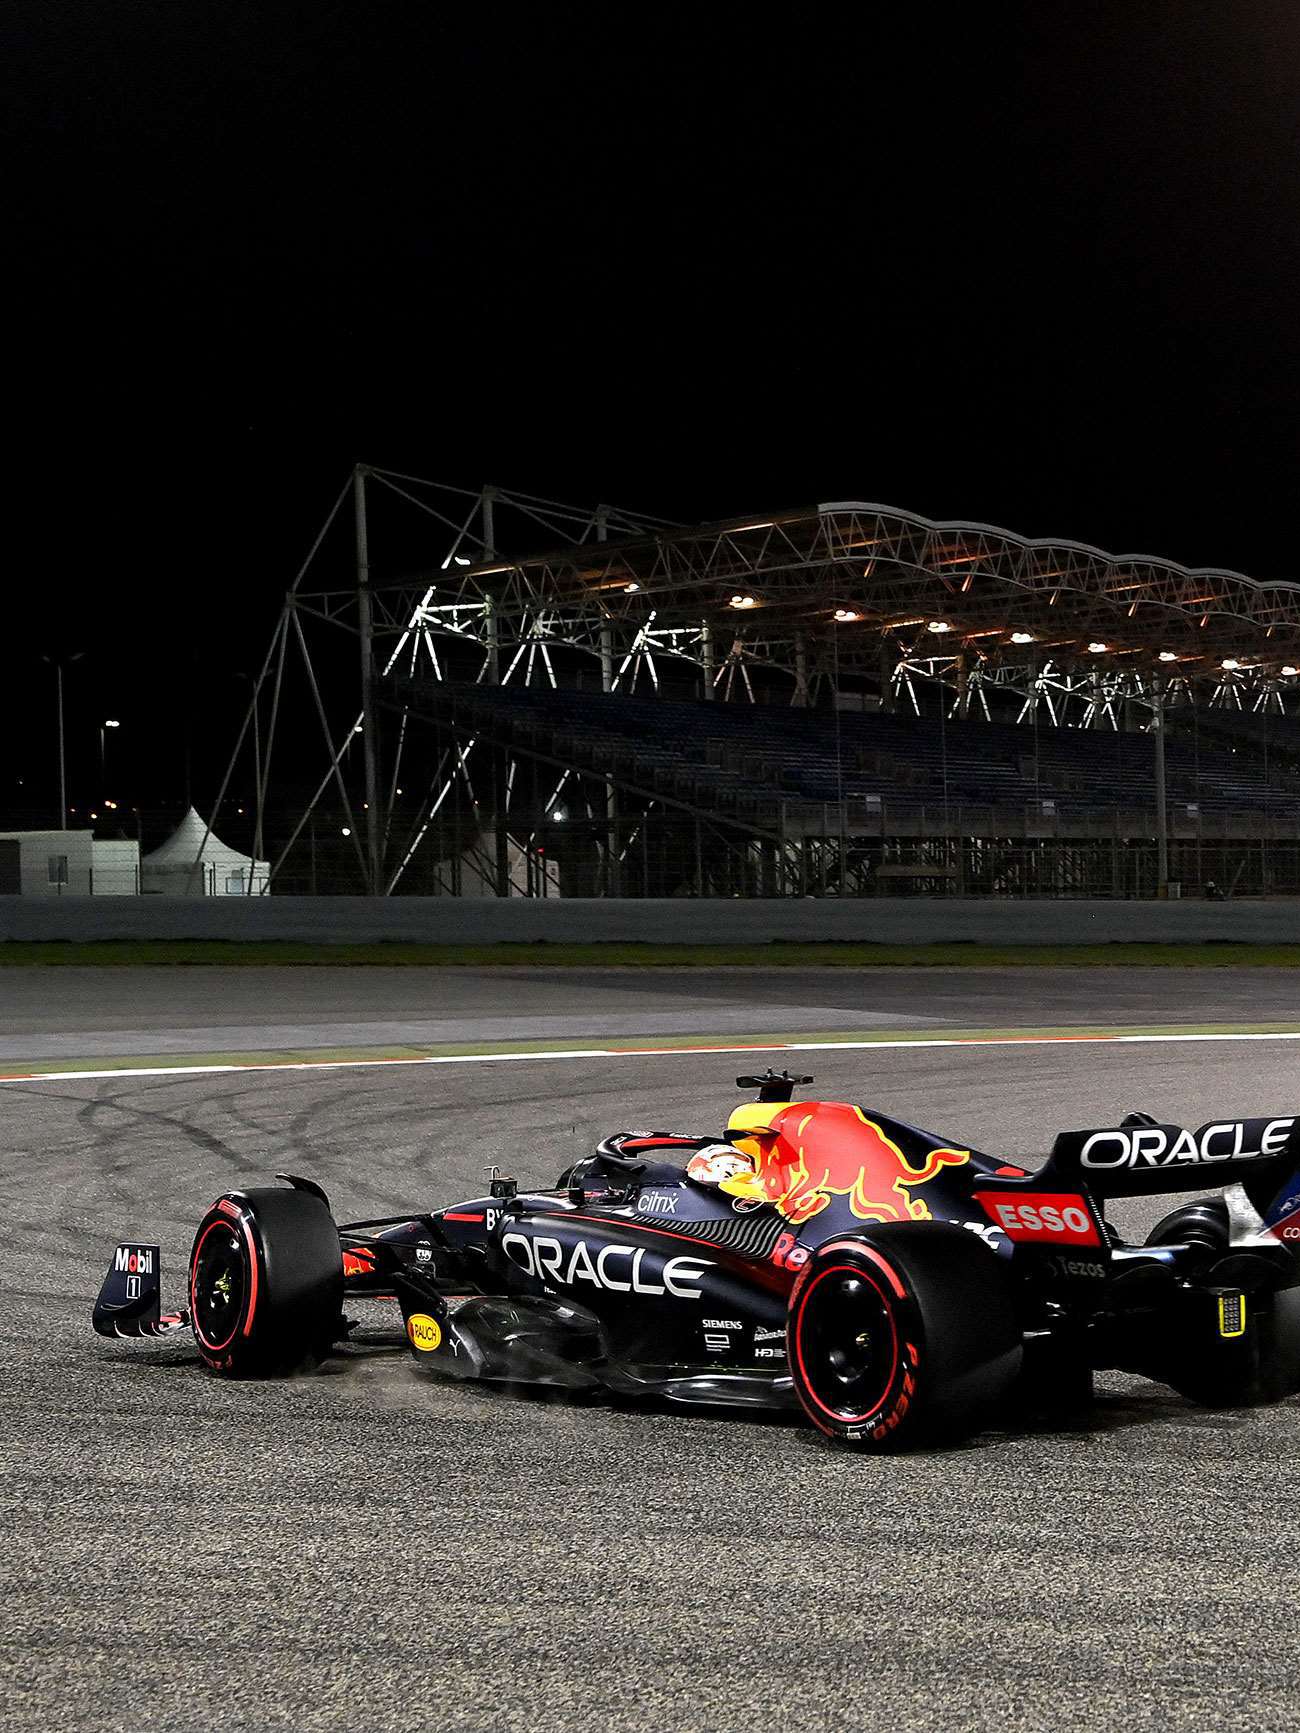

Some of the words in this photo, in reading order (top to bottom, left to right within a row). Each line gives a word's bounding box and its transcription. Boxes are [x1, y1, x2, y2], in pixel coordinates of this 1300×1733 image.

[1080, 1119, 1295, 1168] ORACLE
[637, 1190, 679, 1213] citrix
[995, 1204, 1090, 1233] ESSO
[114, 1247, 153, 1274] Mobil
[502, 1232, 718, 1299] ORACLE
[702, 1319, 743, 1329] SIEMENS
